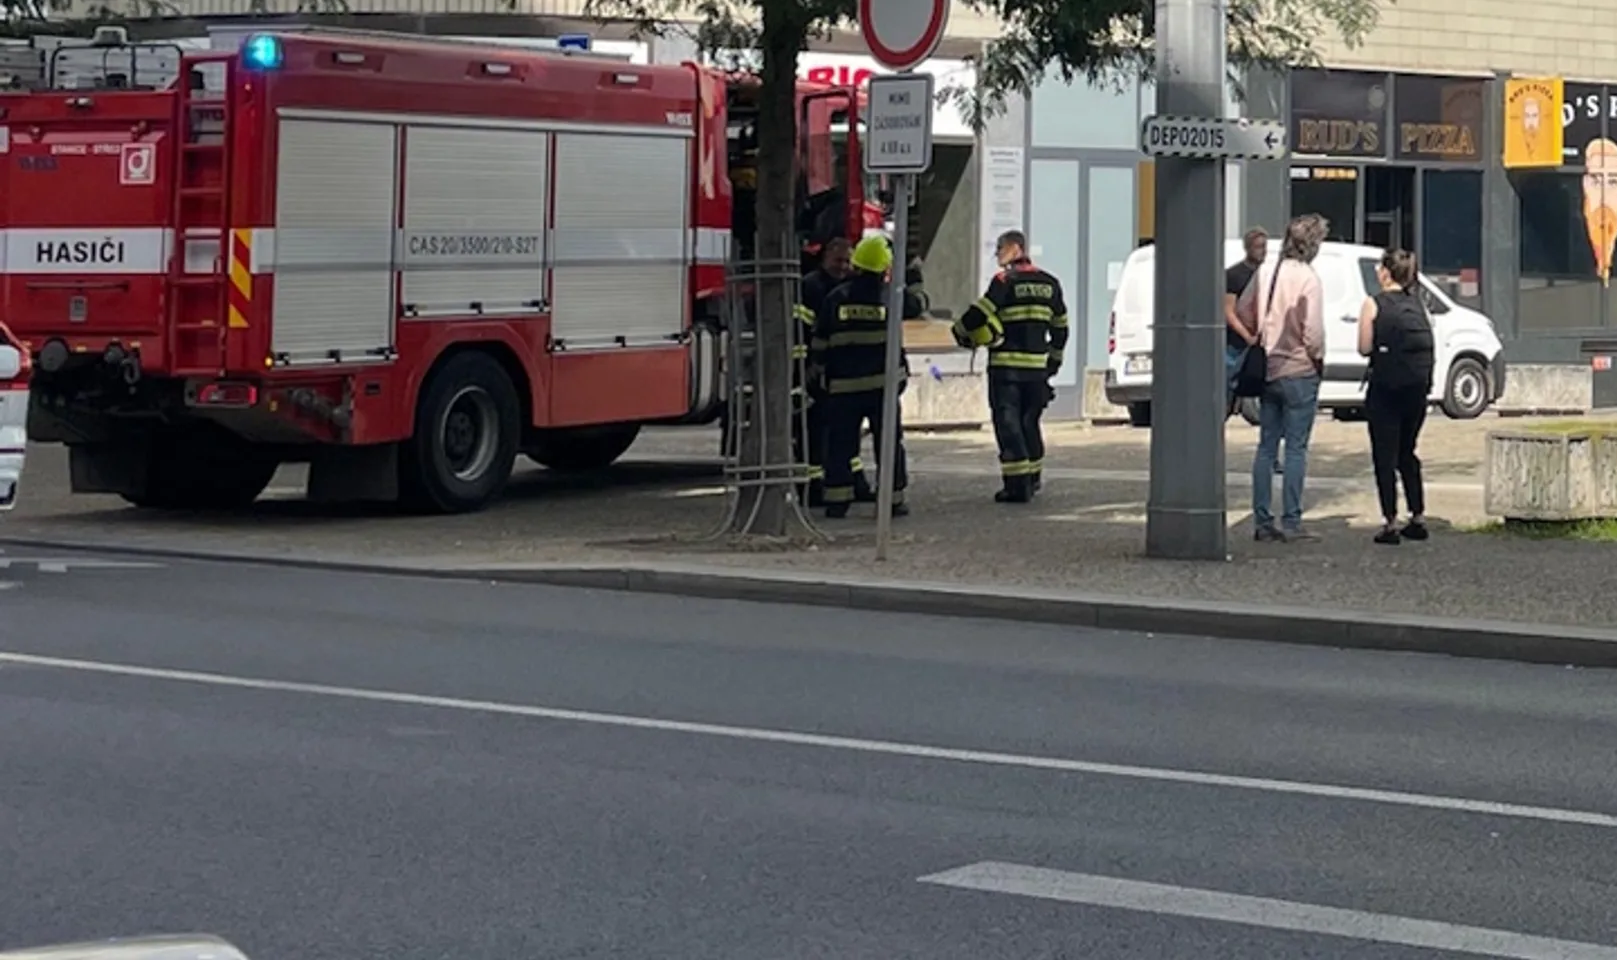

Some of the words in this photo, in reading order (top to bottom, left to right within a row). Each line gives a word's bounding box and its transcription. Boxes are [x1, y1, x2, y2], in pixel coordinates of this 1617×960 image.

[1151, 126, 1225, 148] DEPO2015
[1298, 119, 1380, 152] RUD'S
[1400, 123, 1476, 155] PIZZA
[36, 236, 124, 263] HASIČI
